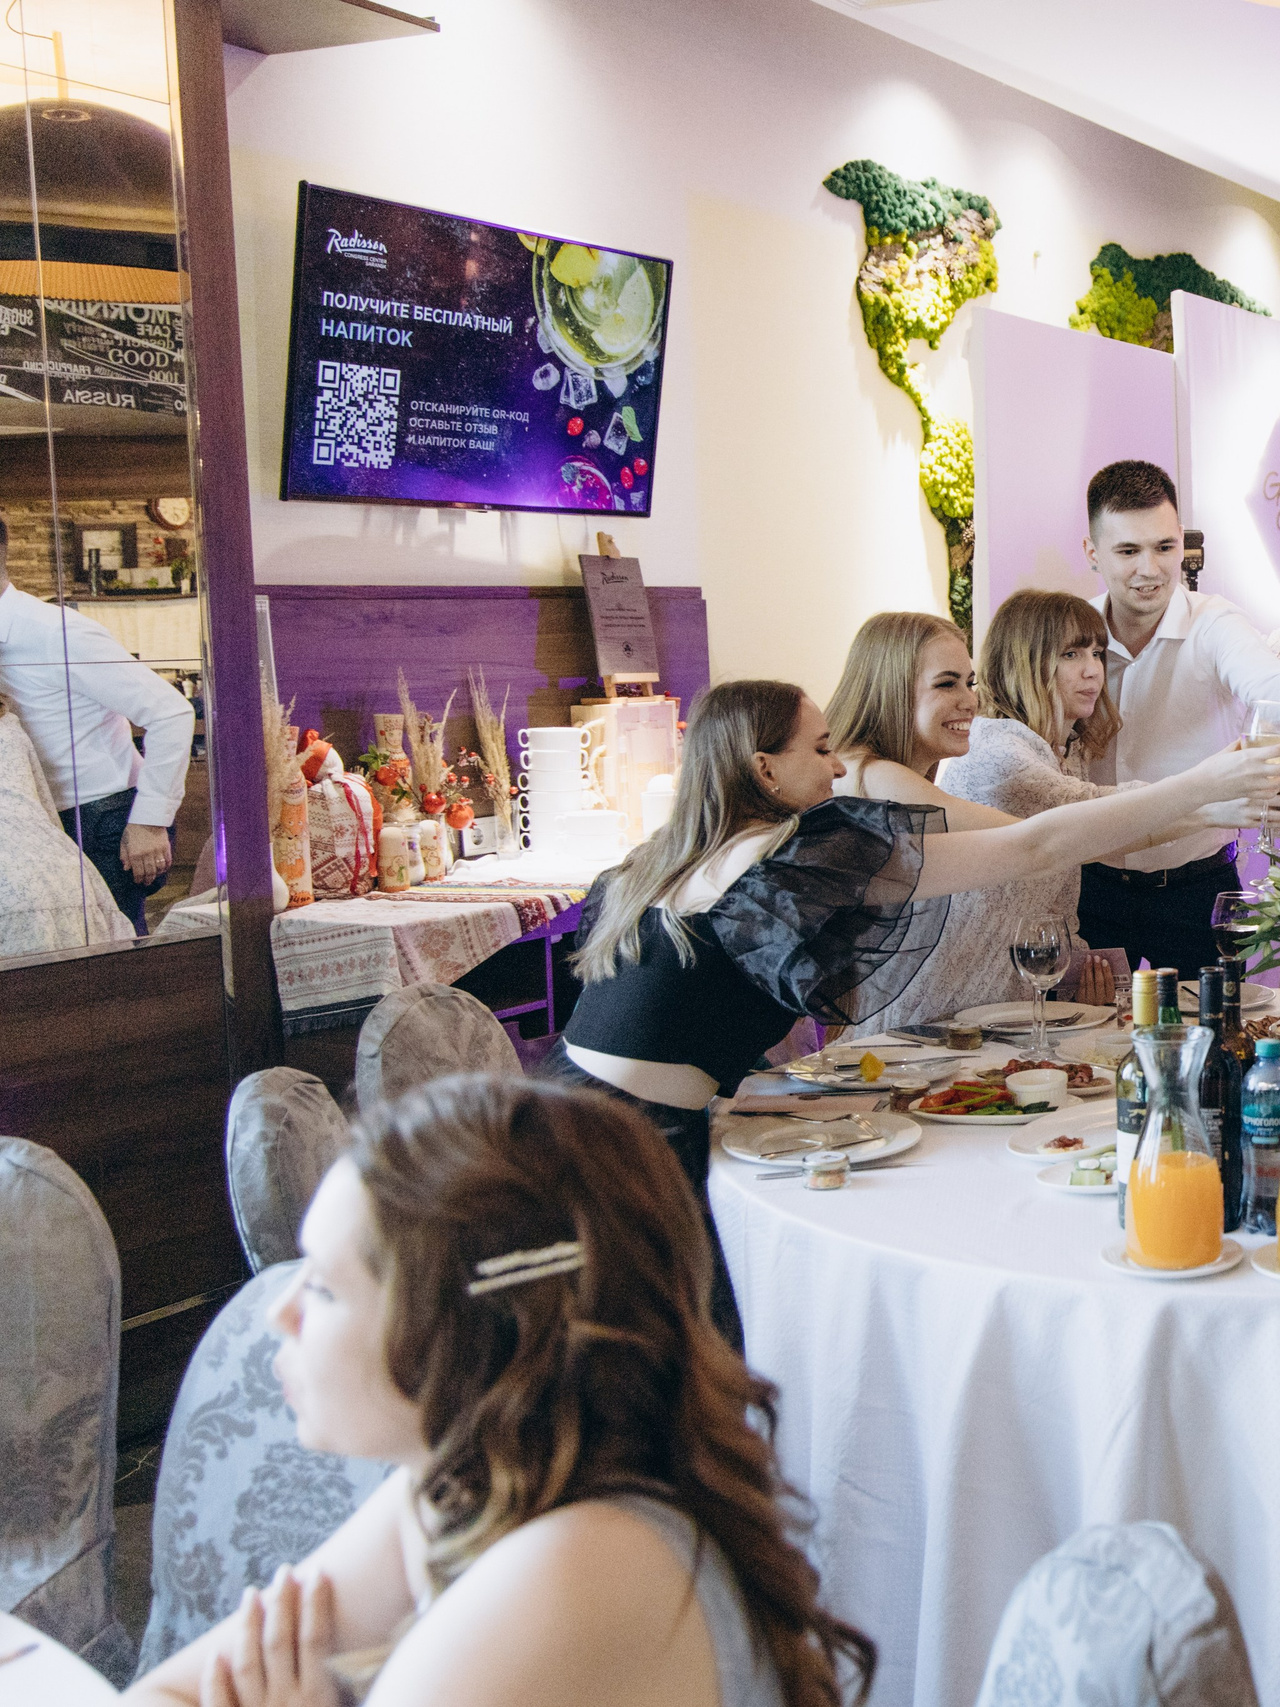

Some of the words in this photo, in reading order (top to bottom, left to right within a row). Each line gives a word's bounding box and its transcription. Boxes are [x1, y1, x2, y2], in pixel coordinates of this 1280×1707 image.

[326, 228, 388, 254] Radisson
[344, 252, 369, 261] CONGRESS
[369, 256, 387, 264] CENTER
[322, 291, 410, 319] ПОЛУЧИТЕ
[413, 305, 513, 334] БЕСПЛАТНЫЙ
[321, 318, 413, 347] НАПИТОК
[108, 348, 169, 368] GOOD
[410, 400, 490, 418] ОТСКАНИРУЙТЕ
[492, 409, 529, 423] QR-КОД
[409, 417, 462, 432] ОСТАВЬТЕ
[464, 423, 498, 435] ОТЗЫВ
[418, 435, 466, 449] НАПИТОК
[468, 439, 495, 451] ВАШ!
